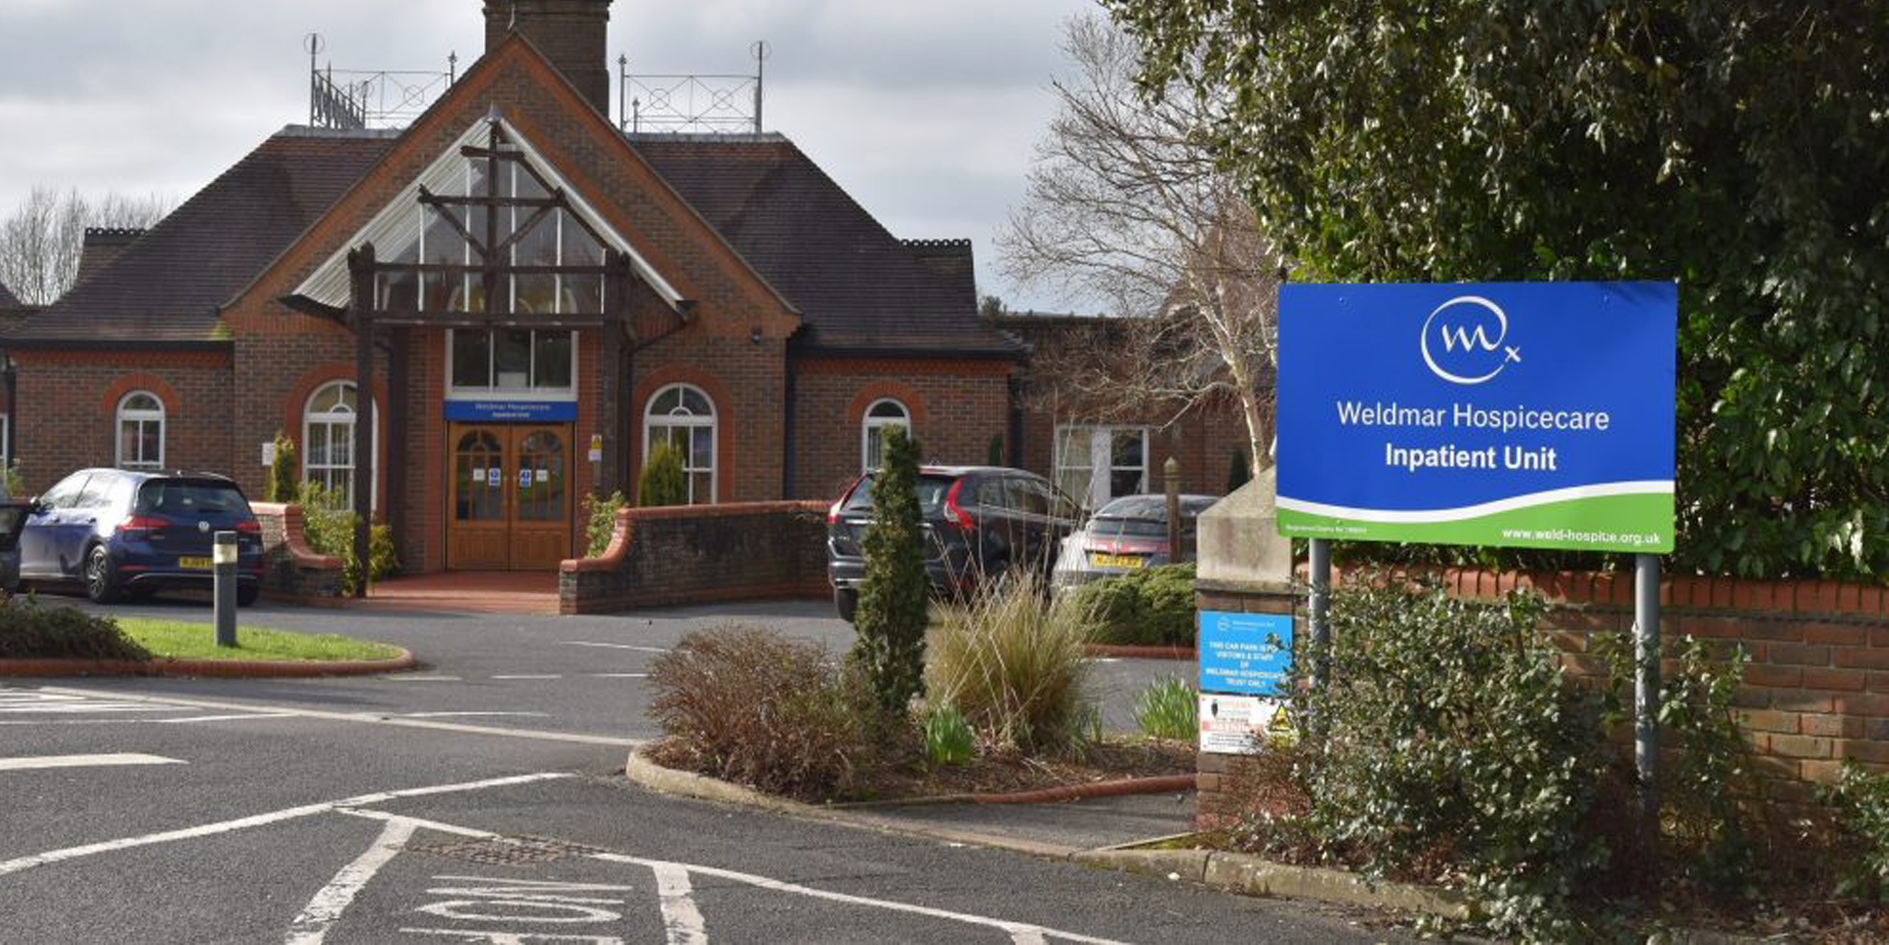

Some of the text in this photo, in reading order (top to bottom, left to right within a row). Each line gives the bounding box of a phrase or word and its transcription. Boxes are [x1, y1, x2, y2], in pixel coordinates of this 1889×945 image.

[1336, 400, 1610, 433] Weldmar Hospicecare
[1386, 442, 1557, 472] Inpatient Unit
[1225, 642, 1239, 651] CAR
